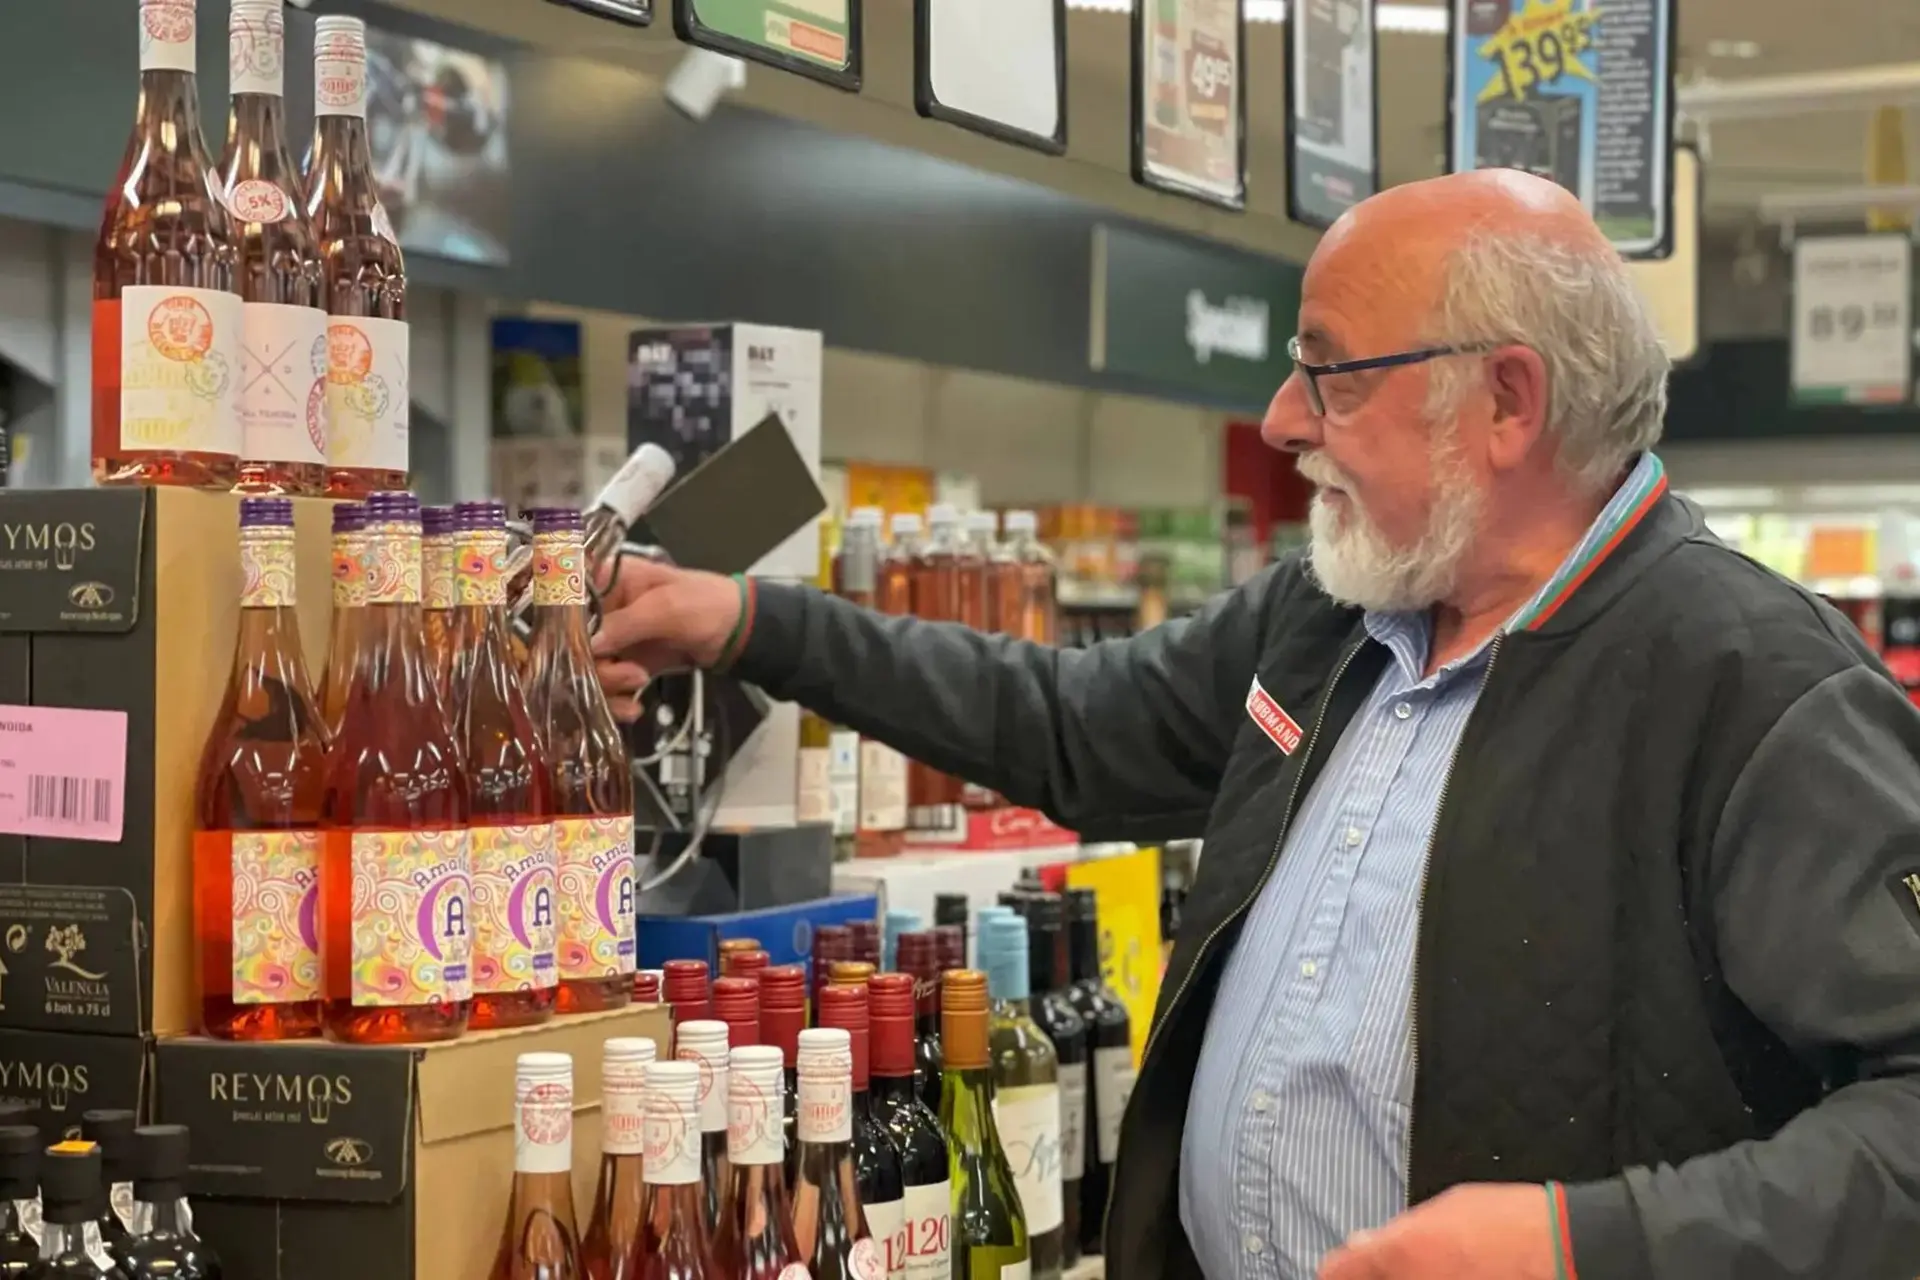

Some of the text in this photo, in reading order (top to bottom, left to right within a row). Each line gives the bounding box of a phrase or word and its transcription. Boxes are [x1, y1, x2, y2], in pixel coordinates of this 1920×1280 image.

[45, 977, 109, 995] VALENCIA
[210, 1072, 353, 1105] REYMOS
[905, 1213, 950, 1256] 120
